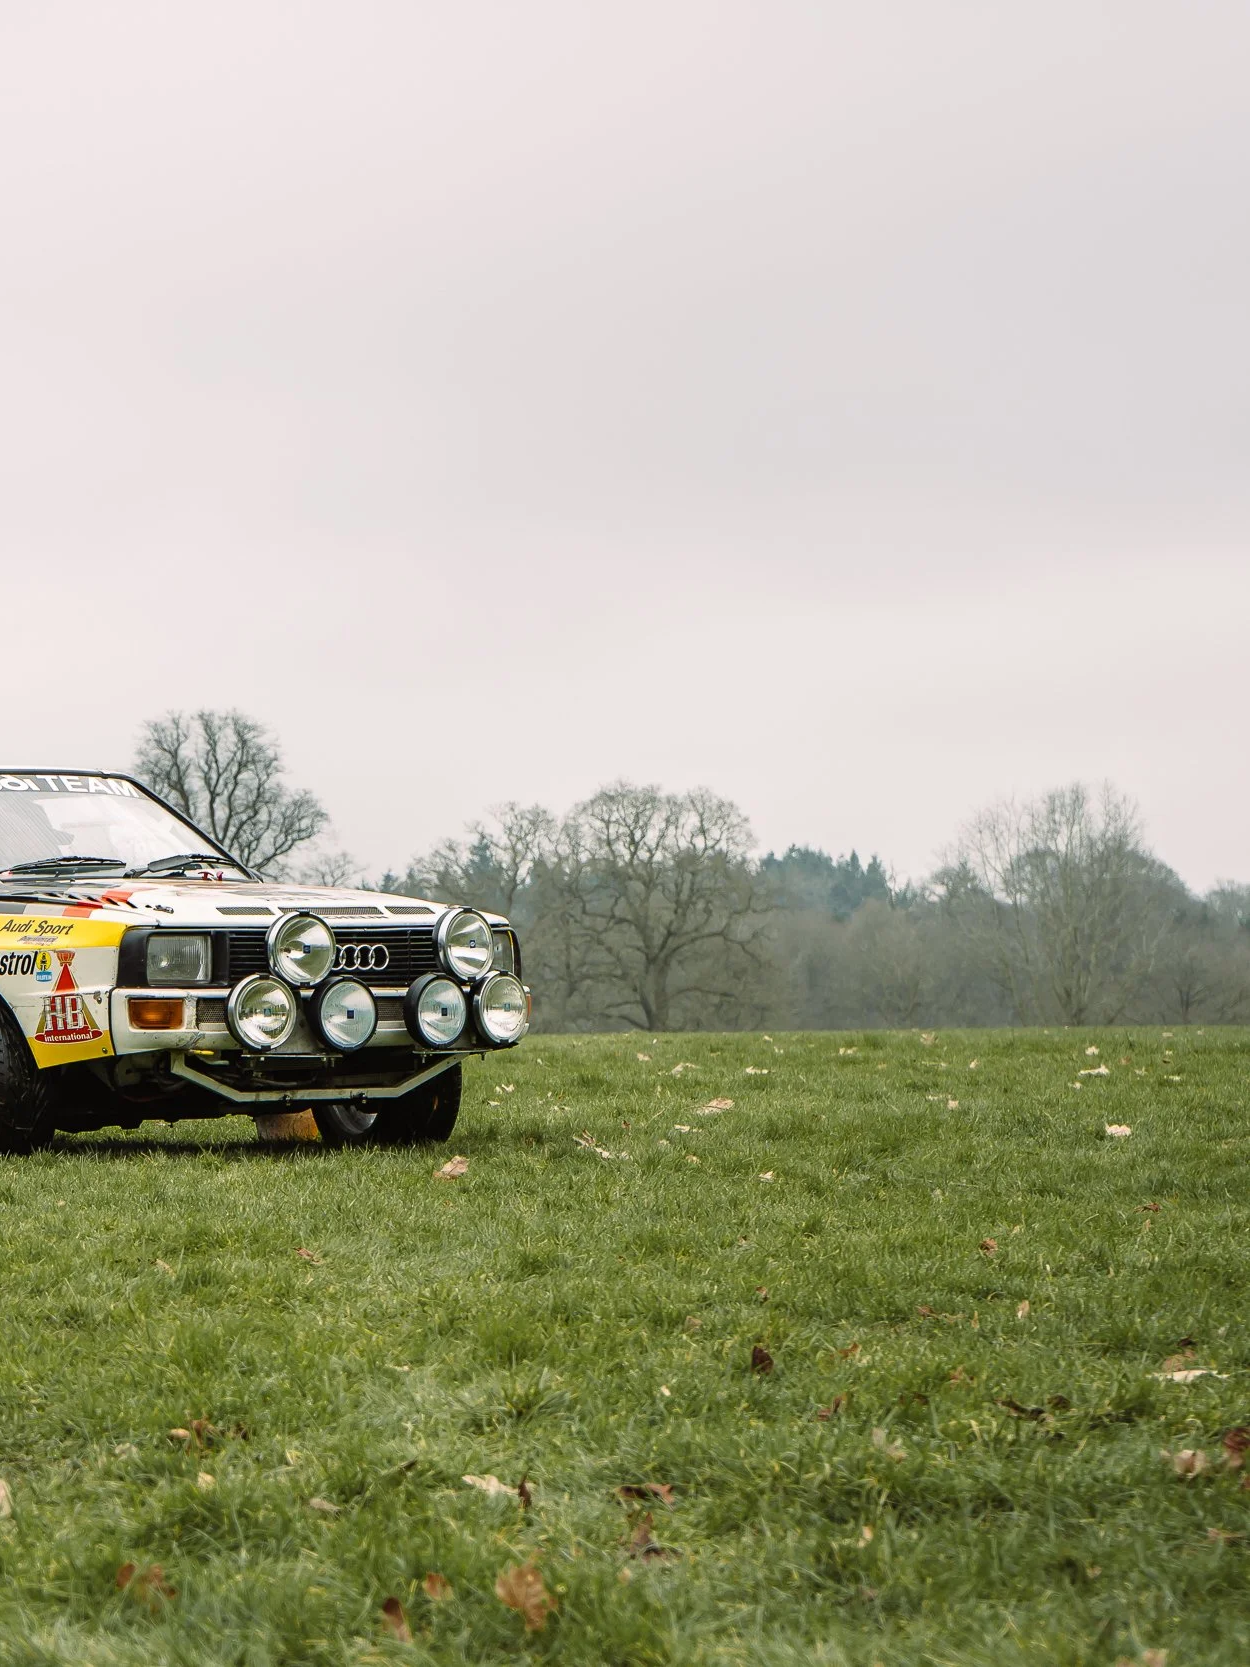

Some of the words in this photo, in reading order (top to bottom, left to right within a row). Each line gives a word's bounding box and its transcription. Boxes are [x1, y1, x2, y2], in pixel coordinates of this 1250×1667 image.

[36, 774, 140, 798] TEAM
[0, 919, 35, 933] Audi
[34, 920, 75, 936] Sport
[43, 995, 85, 1031] HB
[44, 1031, 93, 1042] international
